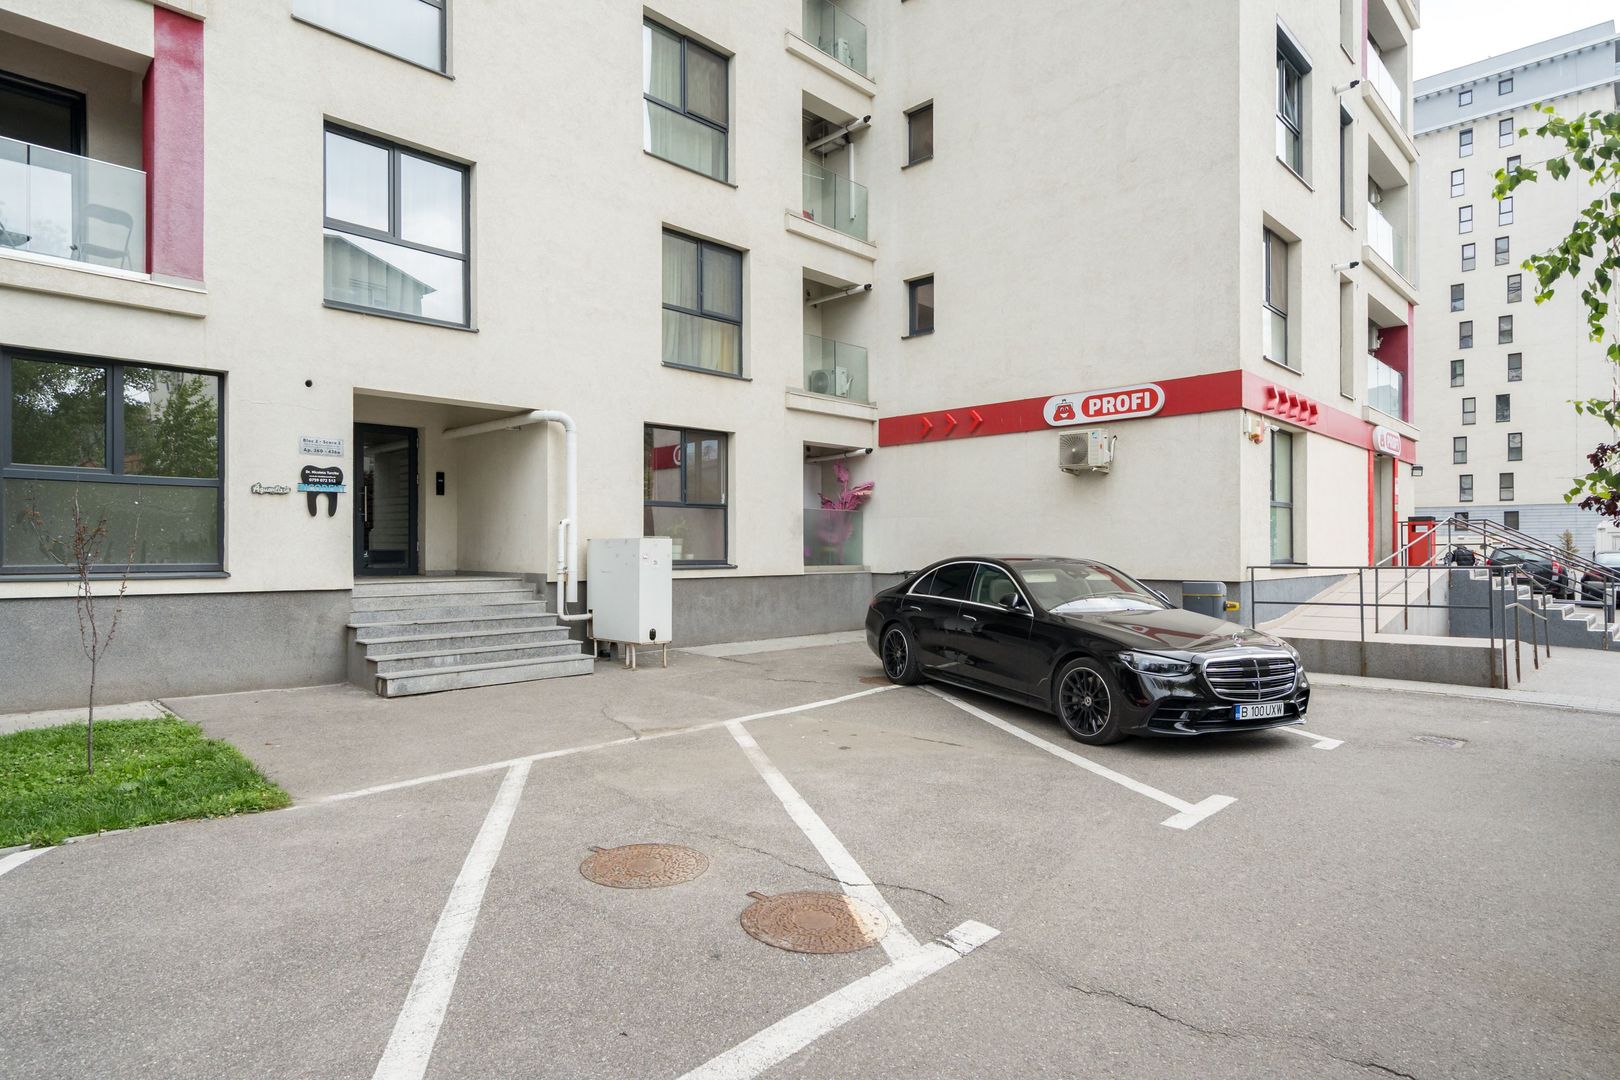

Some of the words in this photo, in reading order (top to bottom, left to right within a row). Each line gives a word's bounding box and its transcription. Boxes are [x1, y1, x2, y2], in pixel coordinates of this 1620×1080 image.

[1088, 391, 1150, 415] PROFI
[1241, 707, 1248, 717] B
[1251, 705, 1265, 717] 100
[1265, 704, 1283, 716] UXW
